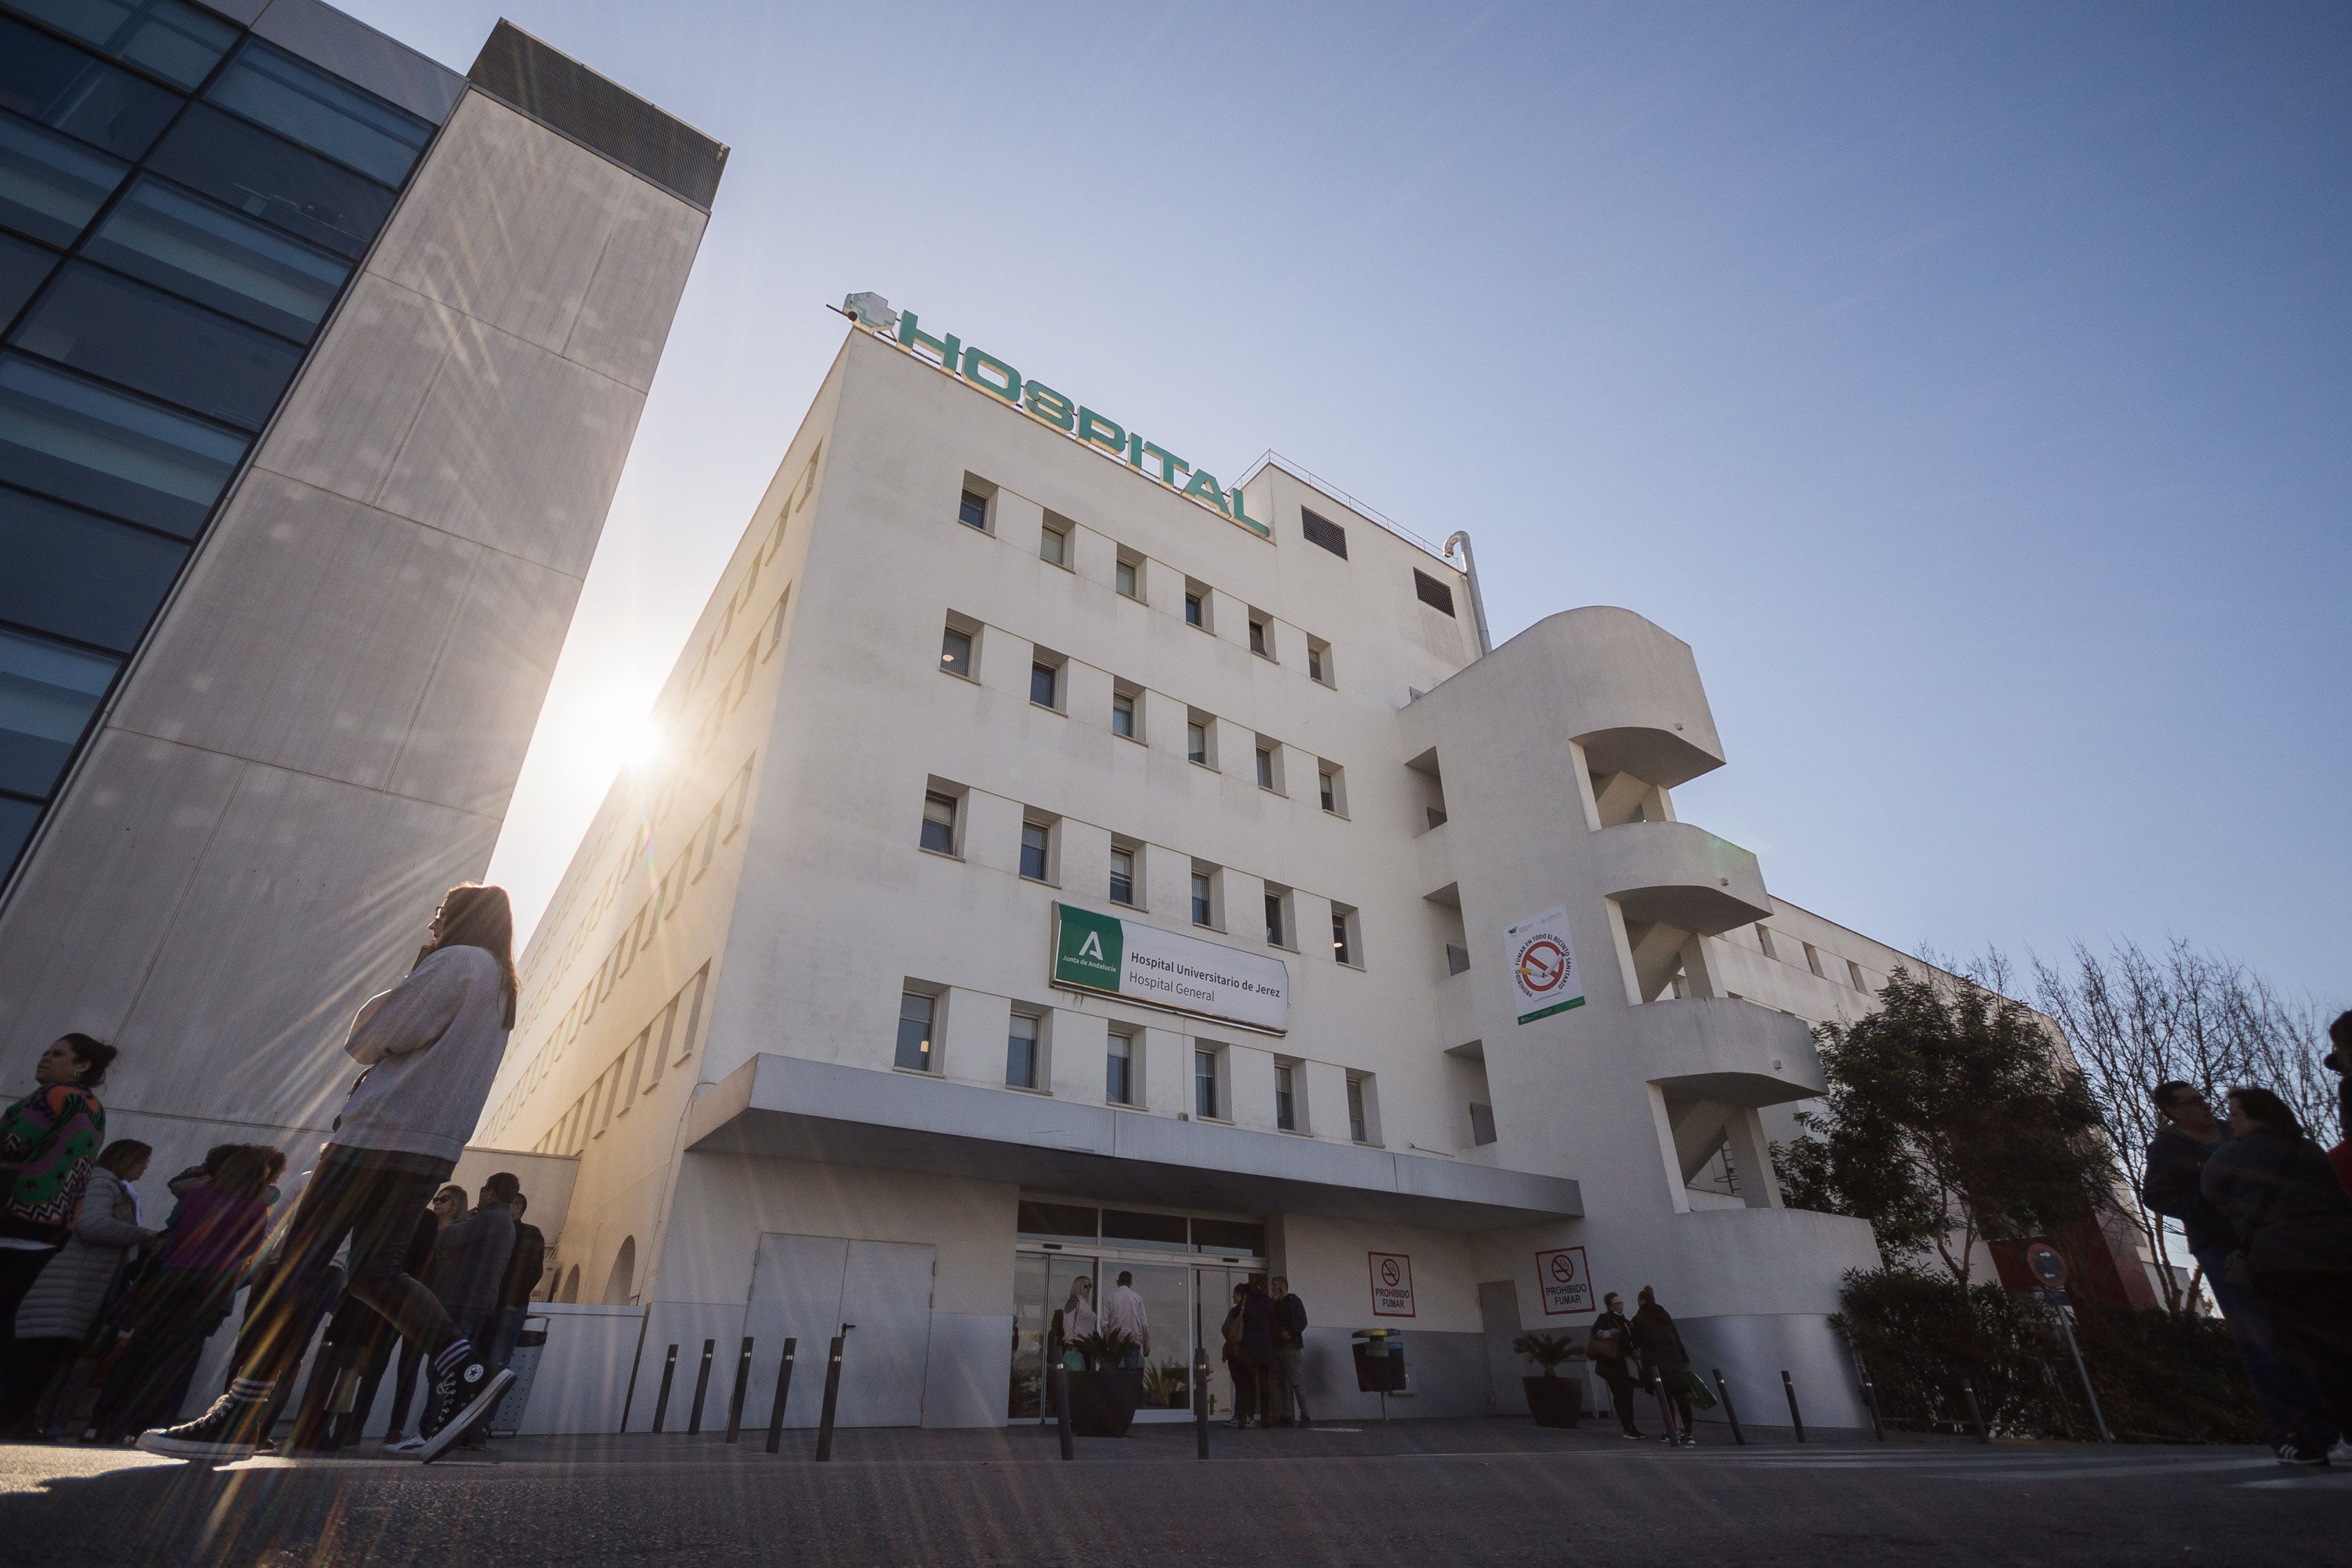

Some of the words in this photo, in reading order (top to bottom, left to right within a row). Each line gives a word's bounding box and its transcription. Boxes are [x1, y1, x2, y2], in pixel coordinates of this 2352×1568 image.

[898, 309, 1269, 538] HOSPITAL
[1532, 933, 1547, 941] TODO
[1554, 936, 1570, 957] RECINTO
[1062, 955, 1079, 964] Junta
[1088, 961, 1117, 972] Andalucía
[1515, 945, 1527, 966] FUMAR
[1131, 952, 1174, 972] Hospital
[1177, 963, 1240, 988] Universitario
[1242, 980, 1253, 992] de
[1255, 983, 1280, 997] Jerez
[1515, 970, 1533, 997] PROHIBIDO
[1558, 957, 1571, 990] SANITARIO
[1130, 971, 1173, 992] Hospital
[1176, 983, 1215, 1002] General
[1375, 1288, 1410, 1299] PROHIBIDO
[1546, 1283, 1587, 1296] PROHIBIDO
[1554, 1294, 1582, 1305] FUMAR
[1382, 1298, 1405, 1309] FUMAR
